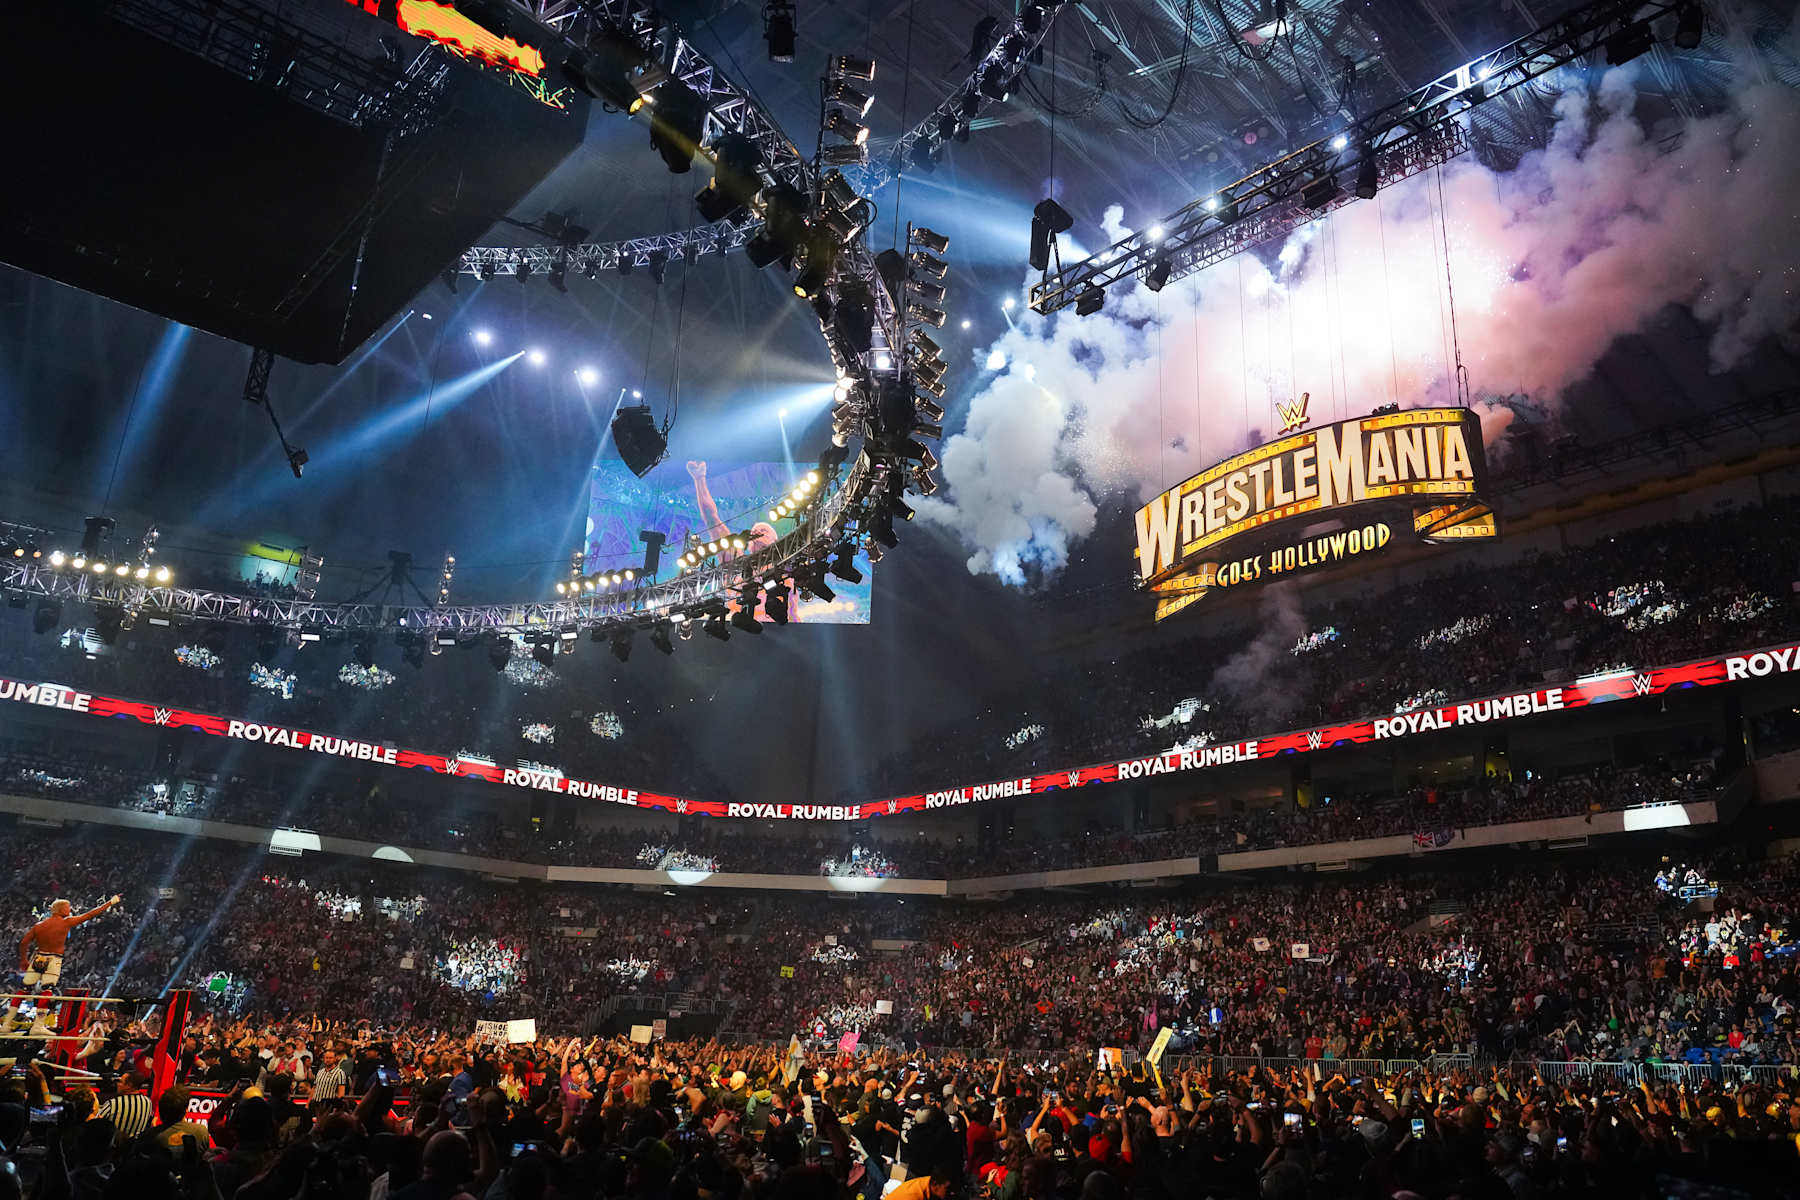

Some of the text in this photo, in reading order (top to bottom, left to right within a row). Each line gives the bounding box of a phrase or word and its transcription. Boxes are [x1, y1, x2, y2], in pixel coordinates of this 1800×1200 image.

[1134, 421, 1474, 580] WRESTLEMANIA
[1217, 523, 1391, 587] GOES HOLLYWOOD
[1726, 647, 1800, 680] ROY
[1374, 688, 1564, 739] ROYAL RUMBLE
[228, 720, 398, 764] ROYAL RUMBLE
[1118, 741, 1258, 779] ROYAL RUMBLE
[503, 769, 639, 805] ROYAL RUMBLE
[926, 778, 1032, 808] ROYAL RUMBLE
[728, 803, 861, 820] ROYAL RUMBLE
